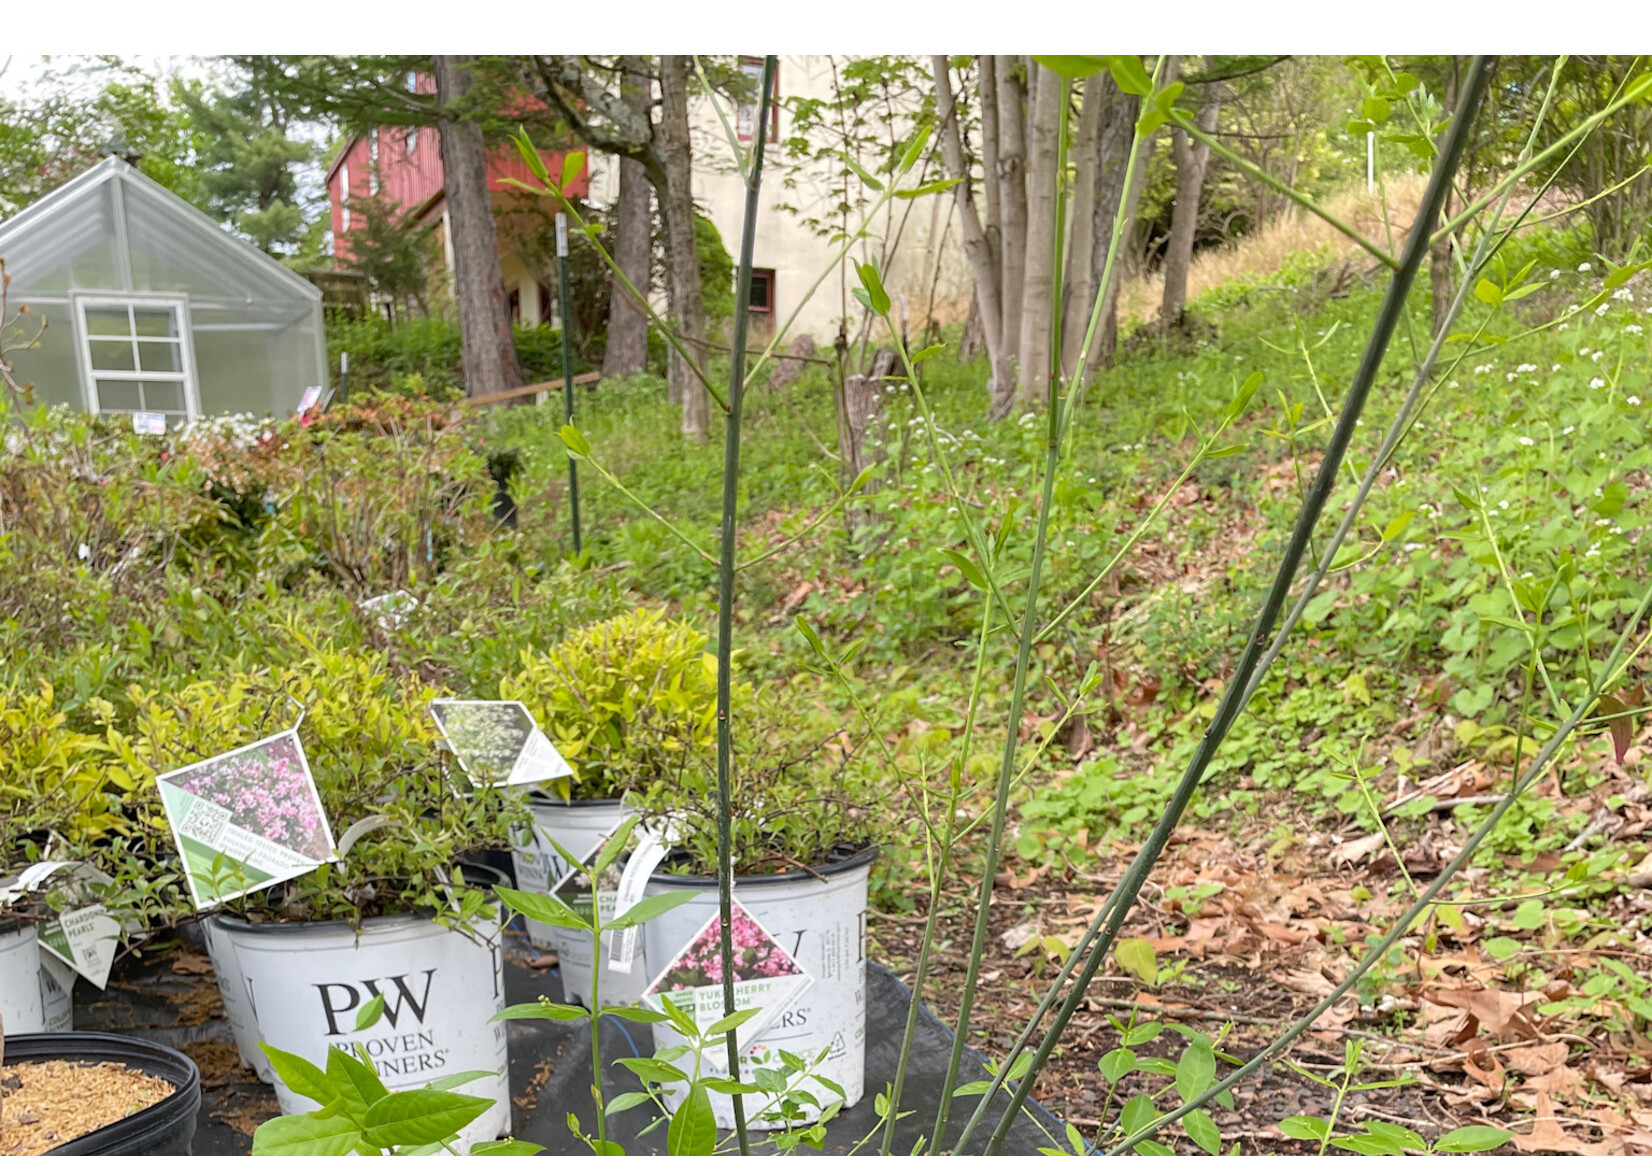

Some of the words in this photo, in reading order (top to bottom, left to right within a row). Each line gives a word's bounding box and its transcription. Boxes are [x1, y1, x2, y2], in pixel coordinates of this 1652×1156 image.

[311, 968, 438, 1036] PW
[699, 990, 723, 1001] YUK
[735, 983, 772, 996] HERRY
[336, 1030, 433, 1059] POVEN
[375, 1049, 448, 1078] NERS
